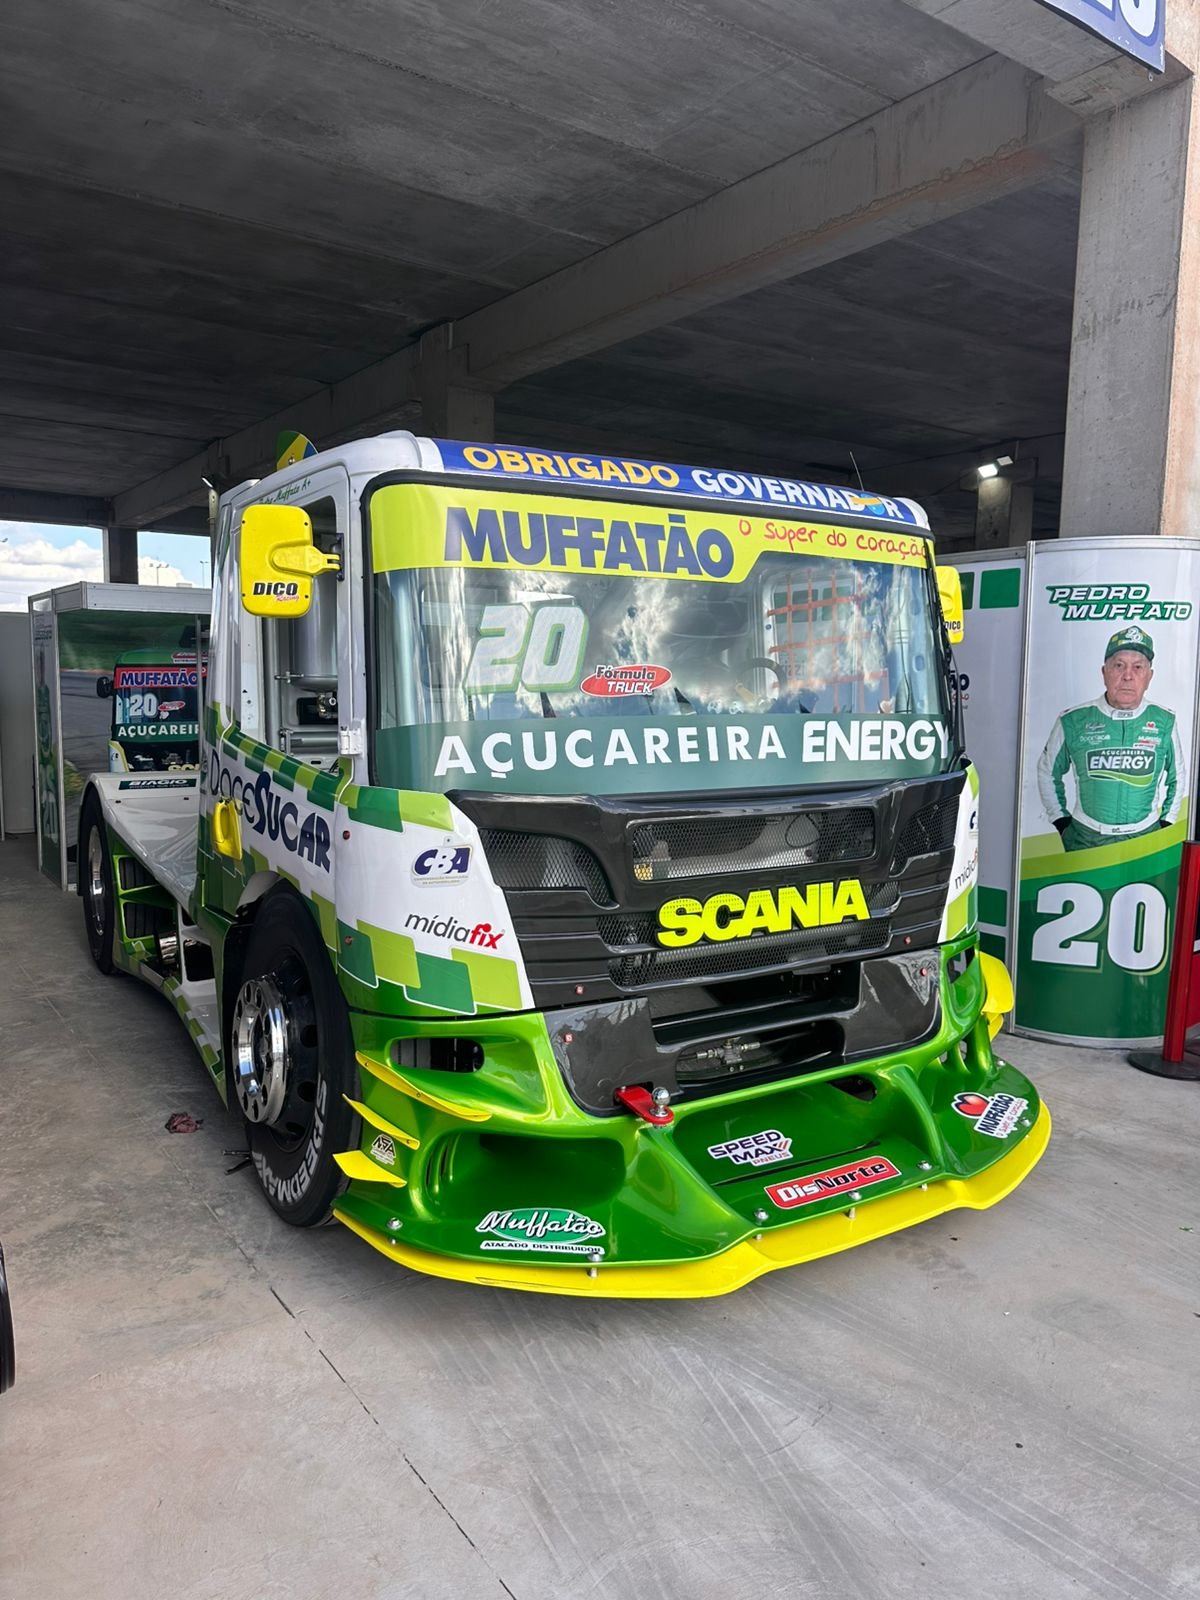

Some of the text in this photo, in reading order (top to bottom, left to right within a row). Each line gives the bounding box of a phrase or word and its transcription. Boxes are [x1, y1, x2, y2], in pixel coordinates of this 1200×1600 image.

[463, 447, 905, 519] OBRIGADO GOVERNADOR
[444, 507, 735, 579] MUFFATÃO
[826, 530, 847, 547] do
[856, 535, 928, 560] coração
[1053, 586, 1146, 601] PEDRO
[1065, 604, 1190, 619] MUFFATO
[464, 605, 590, 693] 20
[120, 668, 198, 687] MUFFATÃO
[596, 666, 656, 680] Fórmula
[607, 681, 653, 693] TRUCK
[129, 693, 158, 718] 20
[434, 719, 949, 779] AÇUCAREIRA ENERGY
[1090, 756, 1154, 769] ENERGY
[414, 847, 471, 875] CBA
[656, 878, 871, 948] SCANIA
[404, 913, 504, 950] mídiafix
[1031, 882, 1167, 971] 20
[710, 1131, 781, 1157] SPEED
[732, 1141, 788, 1164] MAX
[753, 1152, 790, 1165] PNEUS
[776, 1163, 888, 1203] DisNorte
[479, 1210, 602, 1237] Muffatão
[484, 1241, 602, 1253] ATACADO DISTRIBUIDOR
